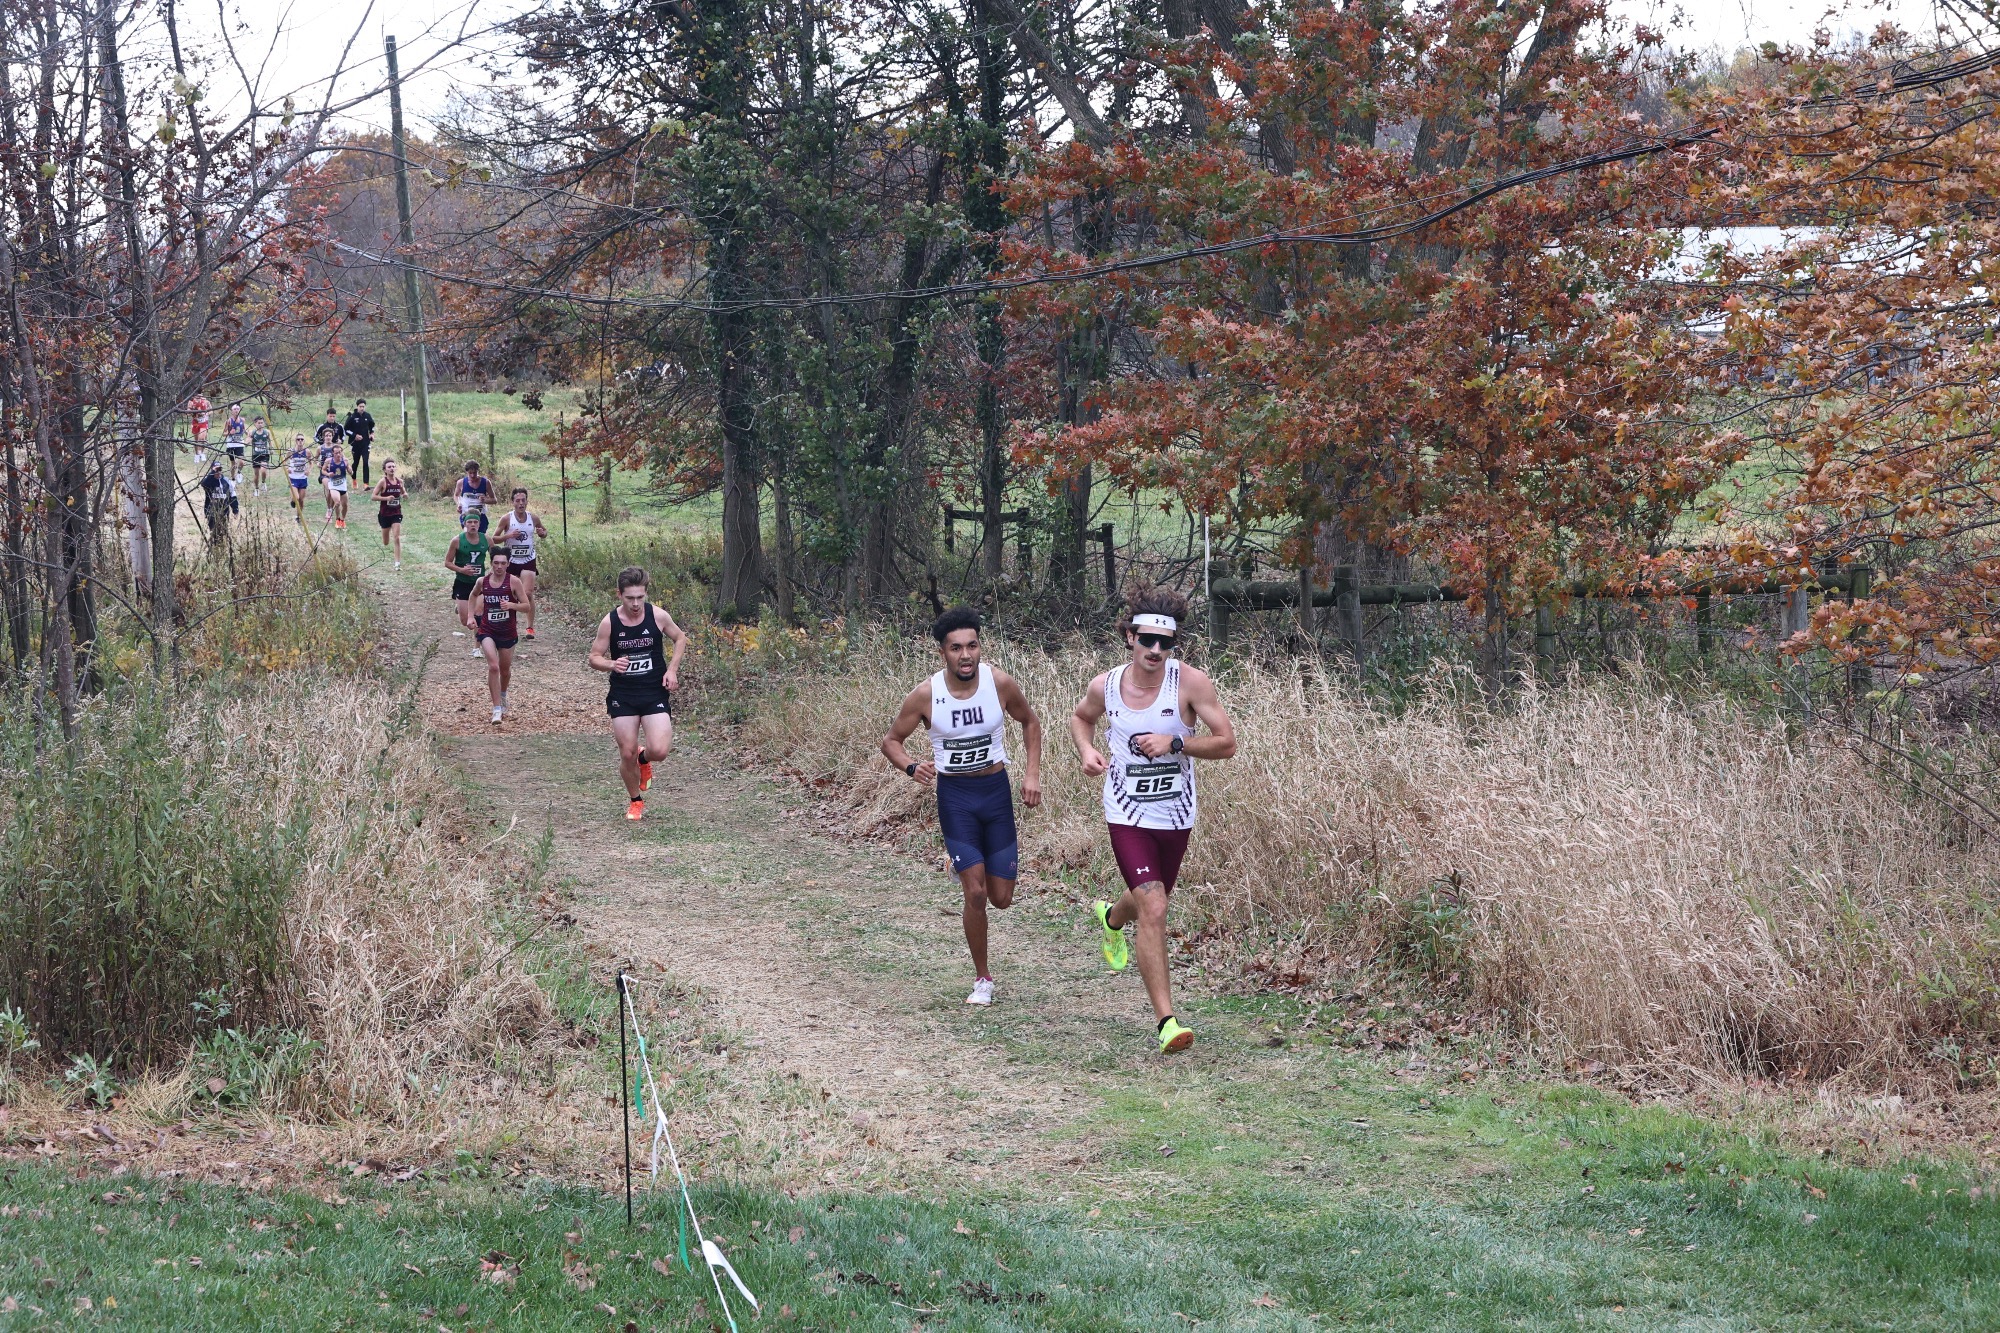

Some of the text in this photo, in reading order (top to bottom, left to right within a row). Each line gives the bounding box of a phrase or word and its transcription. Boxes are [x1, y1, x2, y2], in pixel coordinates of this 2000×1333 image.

[469, 551, 481, 563] Y
[490, 612, 507, 620] 601
[951, 706, 984, 728] FDU
[949, 747, 990, 765] 633
[1135, 776, 1175, 793] 615
